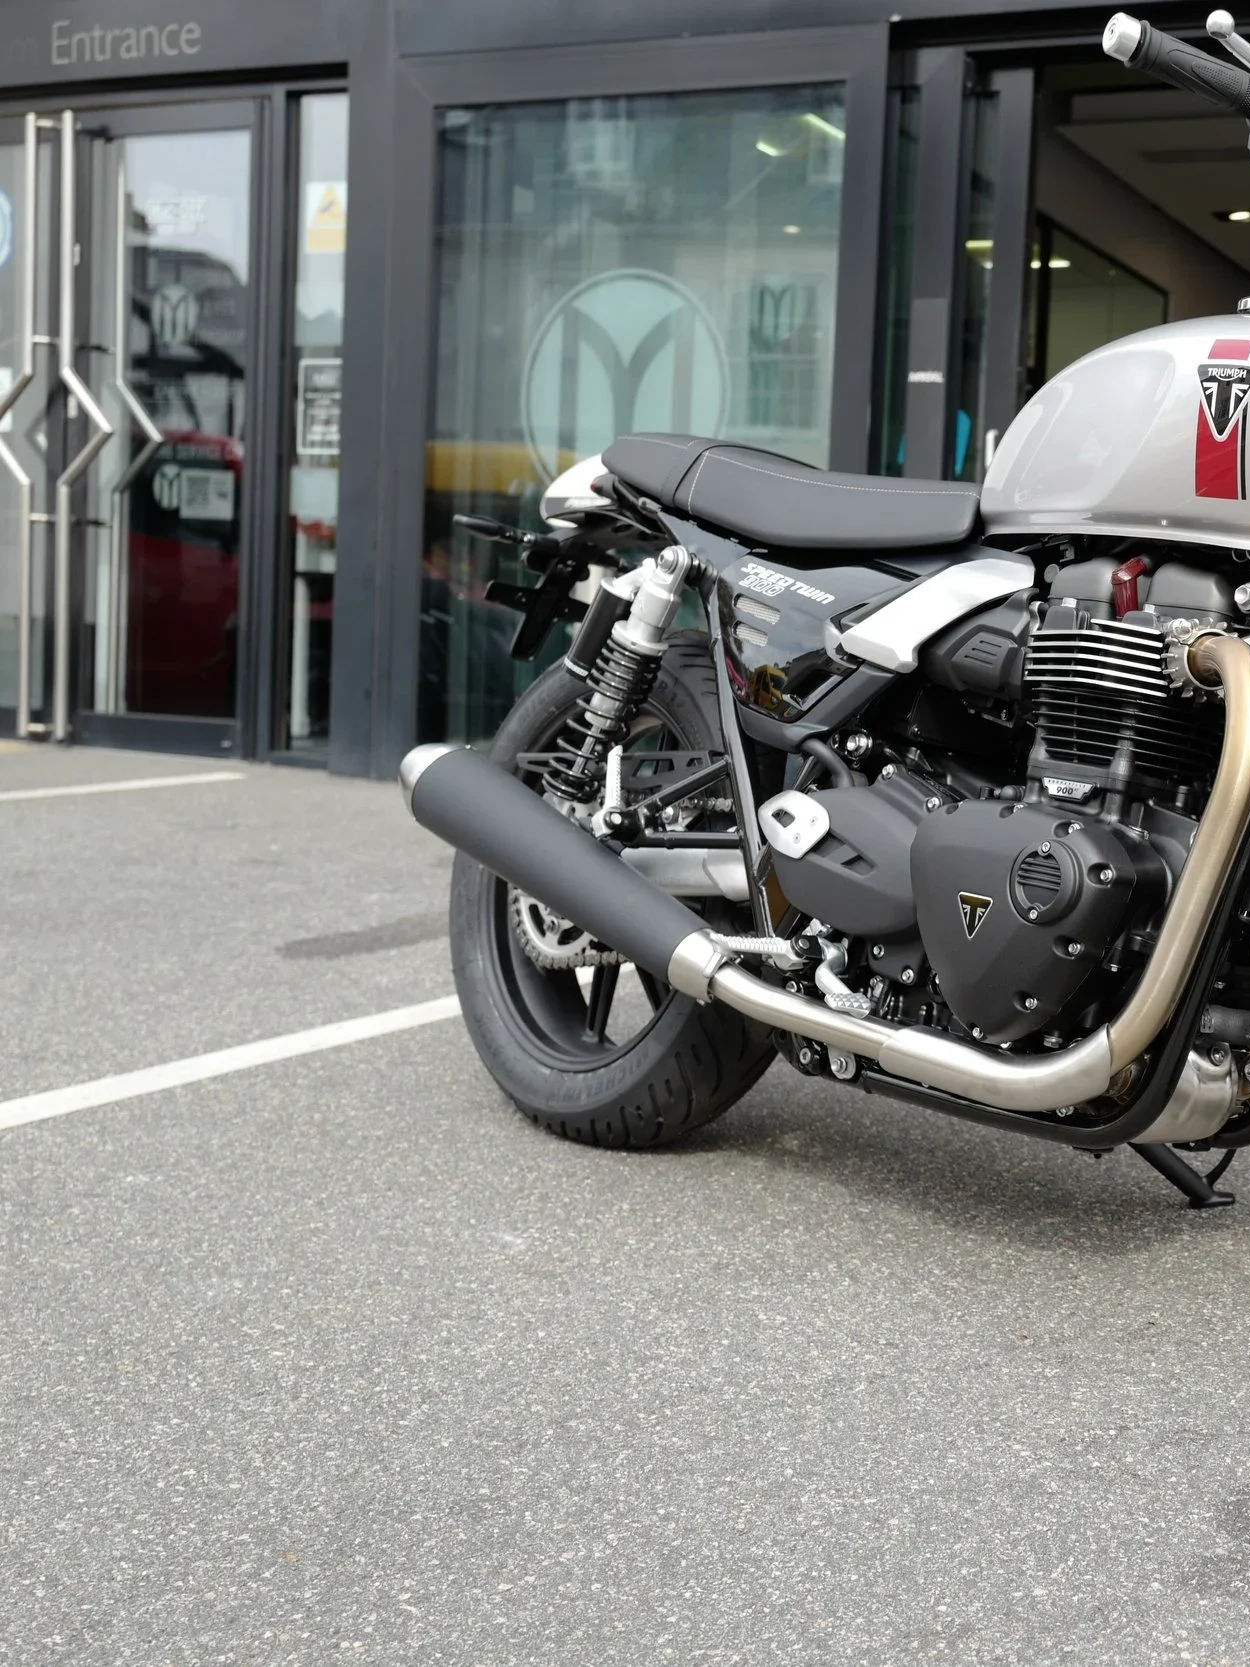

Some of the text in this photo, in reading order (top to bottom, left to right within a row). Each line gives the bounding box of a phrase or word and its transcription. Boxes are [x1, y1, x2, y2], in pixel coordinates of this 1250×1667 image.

[51, 20, 202, 66] Entrance
[1207, 367, 1248, 380] TRIUMPH
[738, 574, 785, 597] 900
[741, 562, 836, 605] SPEED TWIN
[1056, 785, 1074, 796] 900
